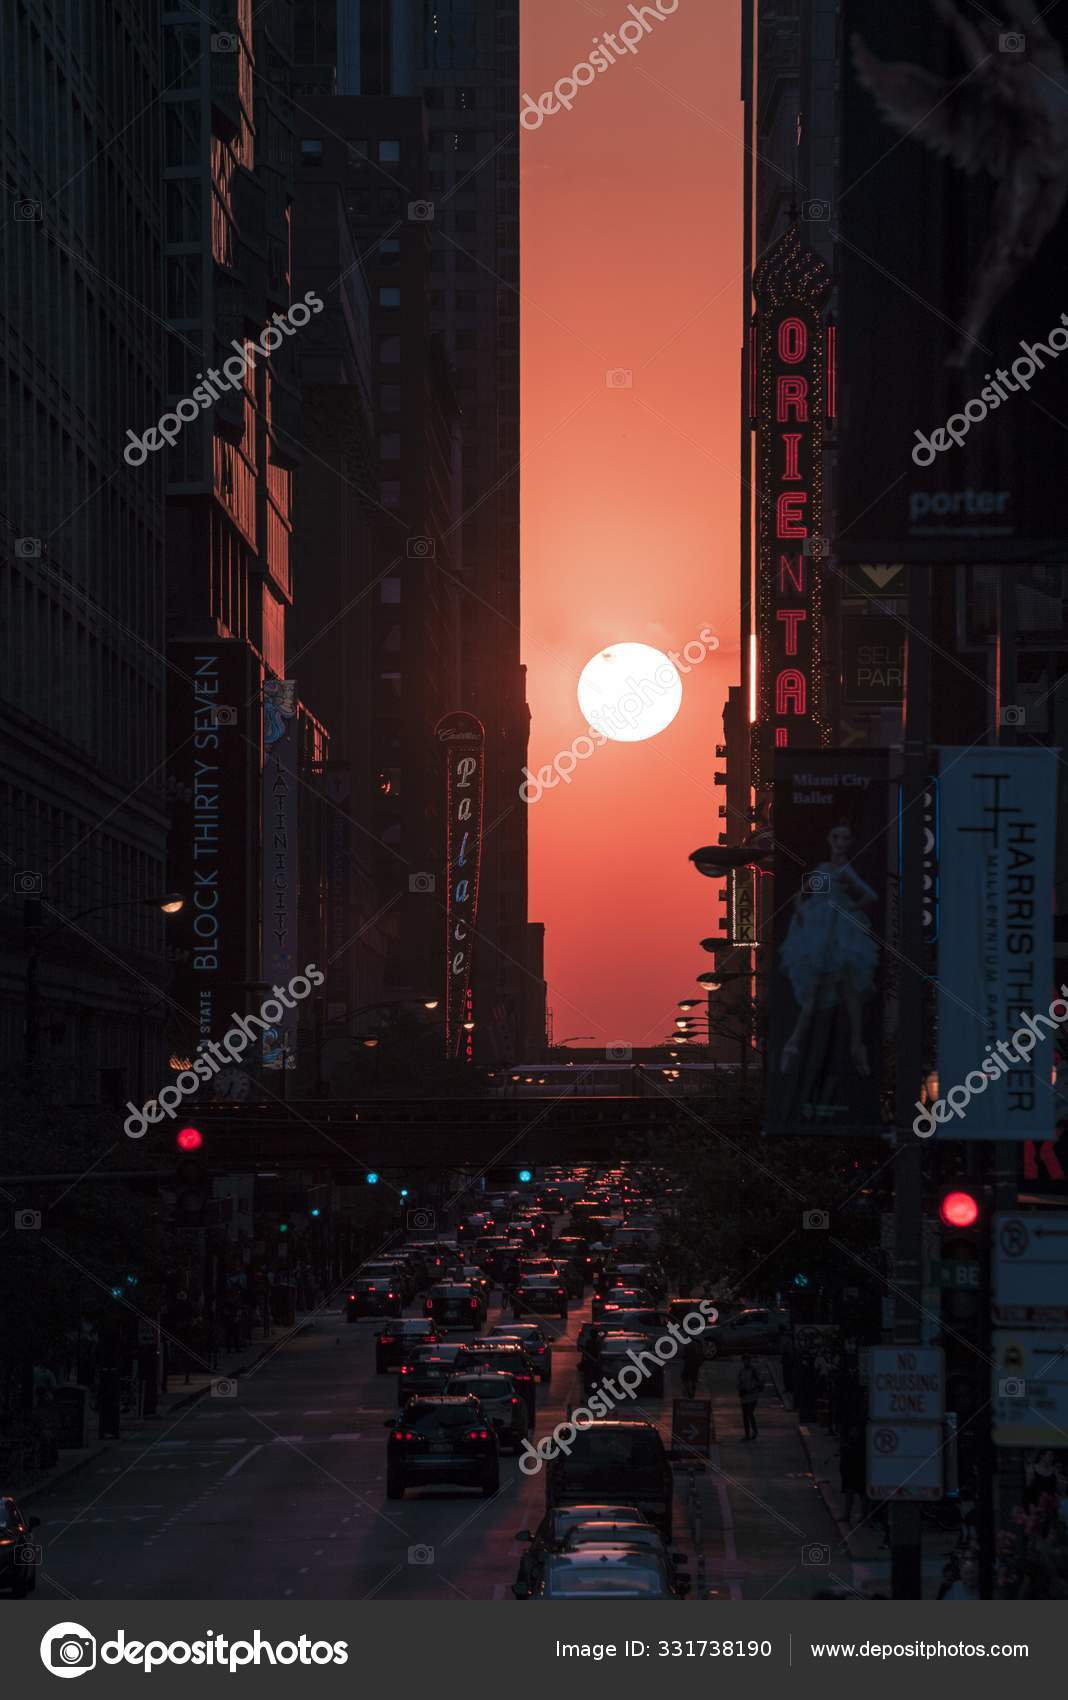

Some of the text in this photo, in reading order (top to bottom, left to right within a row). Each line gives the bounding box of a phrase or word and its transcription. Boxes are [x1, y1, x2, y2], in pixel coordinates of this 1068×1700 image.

[775, 315, 809, 749] ORIENTA
[910, 486, 1010, 522] porter
[193, 655, 219, 970] BLOCK THIRTY SEVEN
[272, 757, 289, 946] LATINICITY
[452, 756, 477, 976] Palace
[200, 991, 212, 1033] STATE
